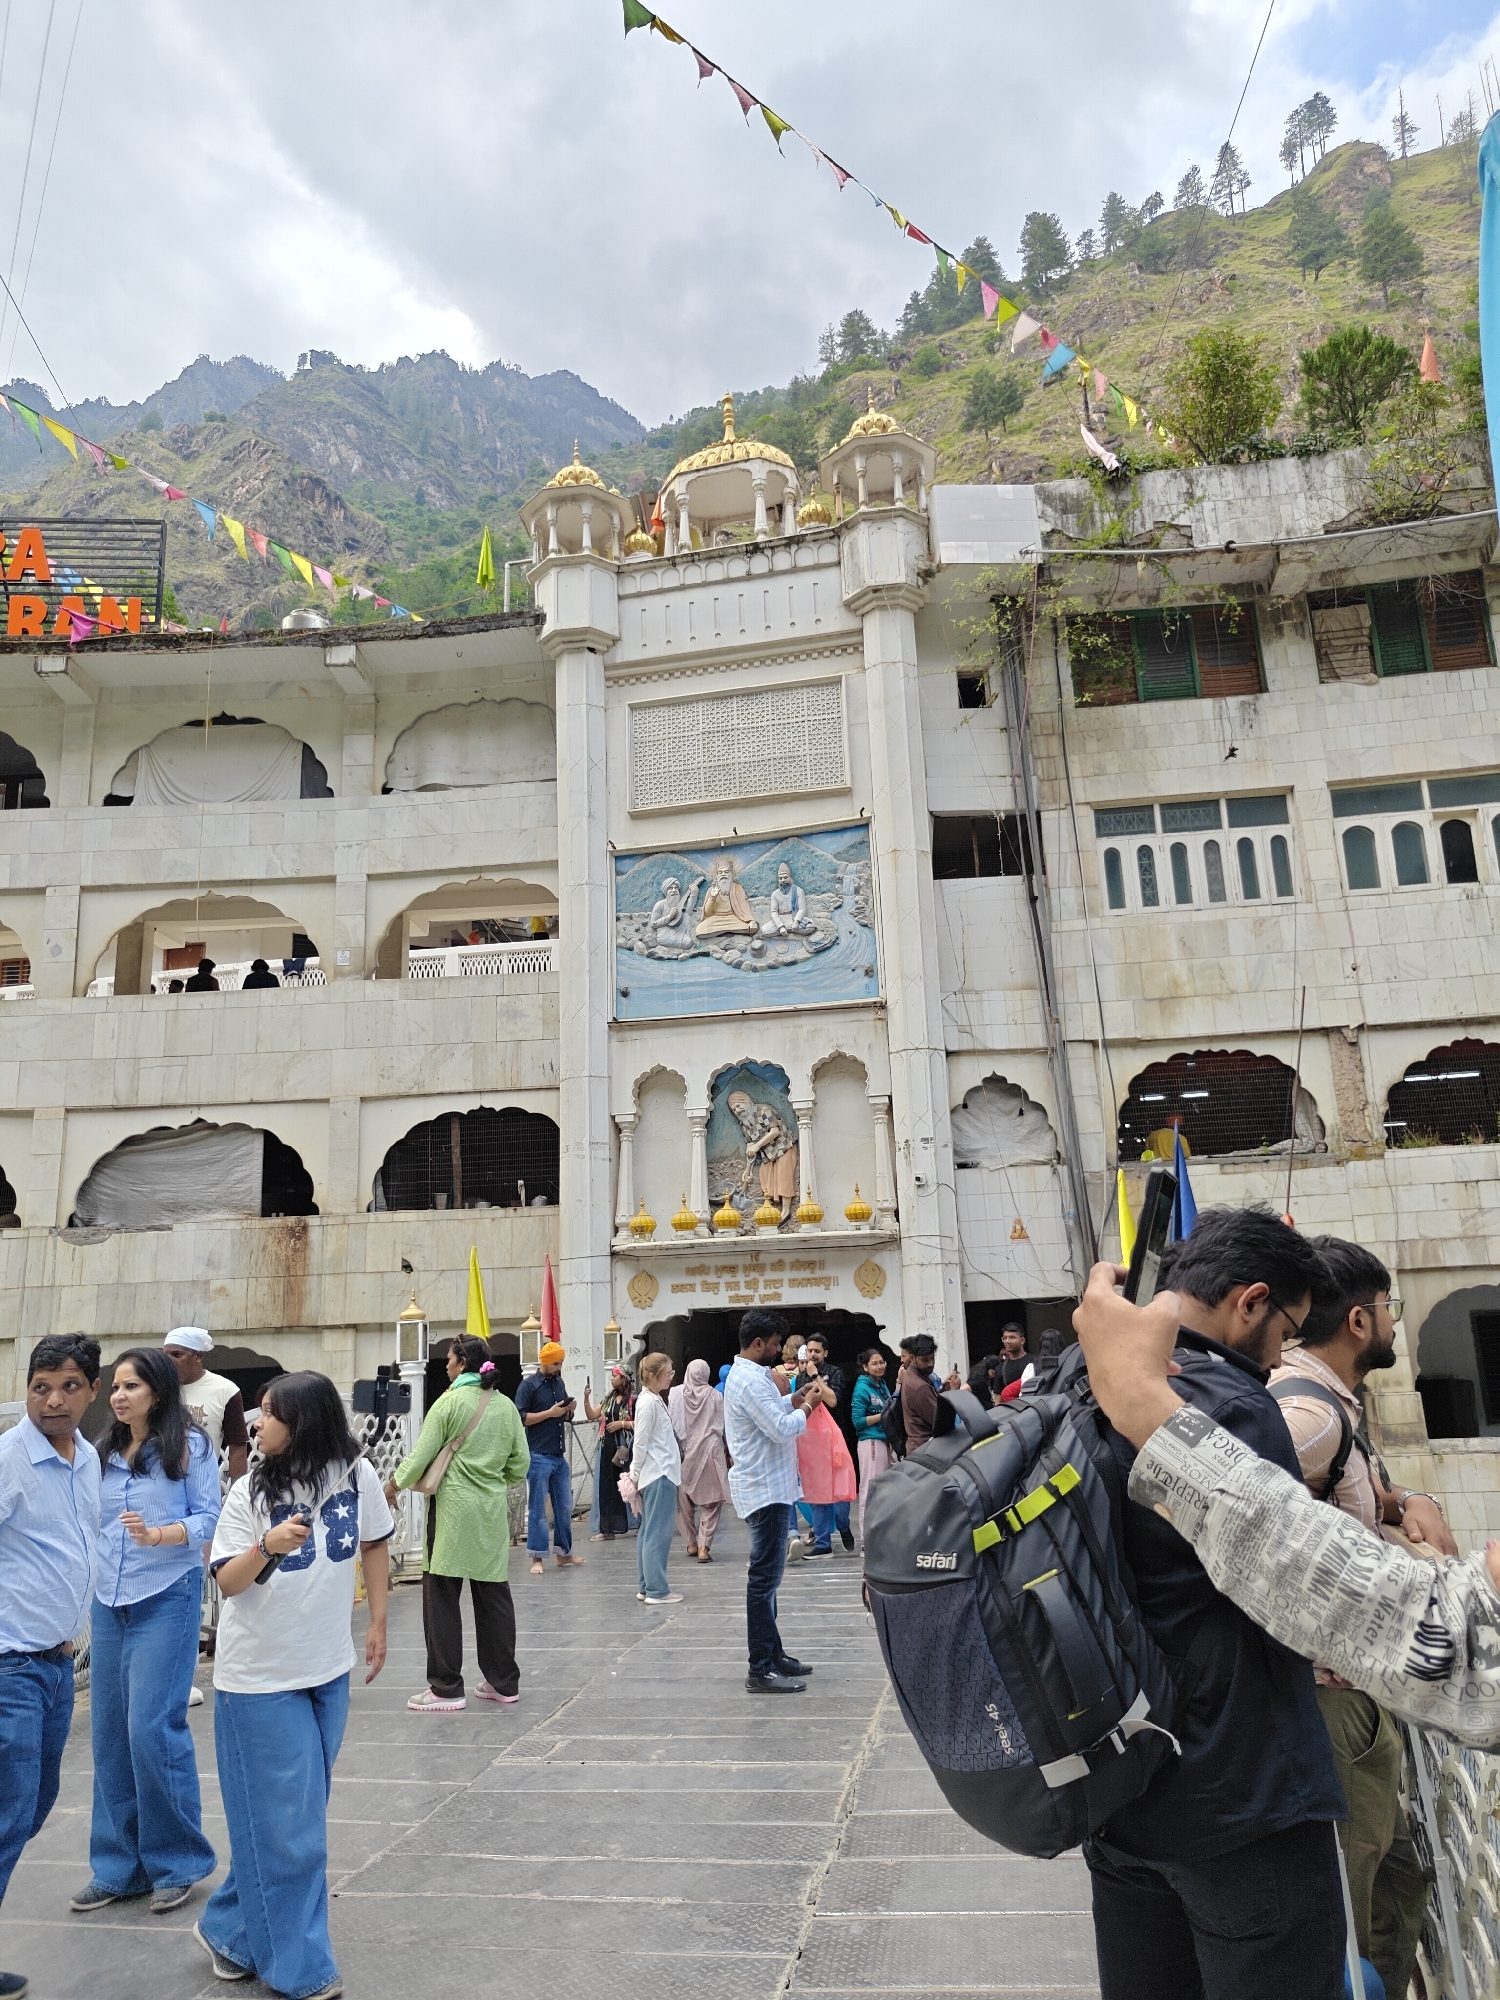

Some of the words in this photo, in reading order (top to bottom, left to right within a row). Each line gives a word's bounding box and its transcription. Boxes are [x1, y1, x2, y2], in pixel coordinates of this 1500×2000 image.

[7, 595, 142, 637] RAN
[916, 1551, 957, 1571] safari
[1362, 1594, 1397, 1647] Water
[984, 1703, 1000, 1720] 45
[994, 1723, 1015, 1755] seek
